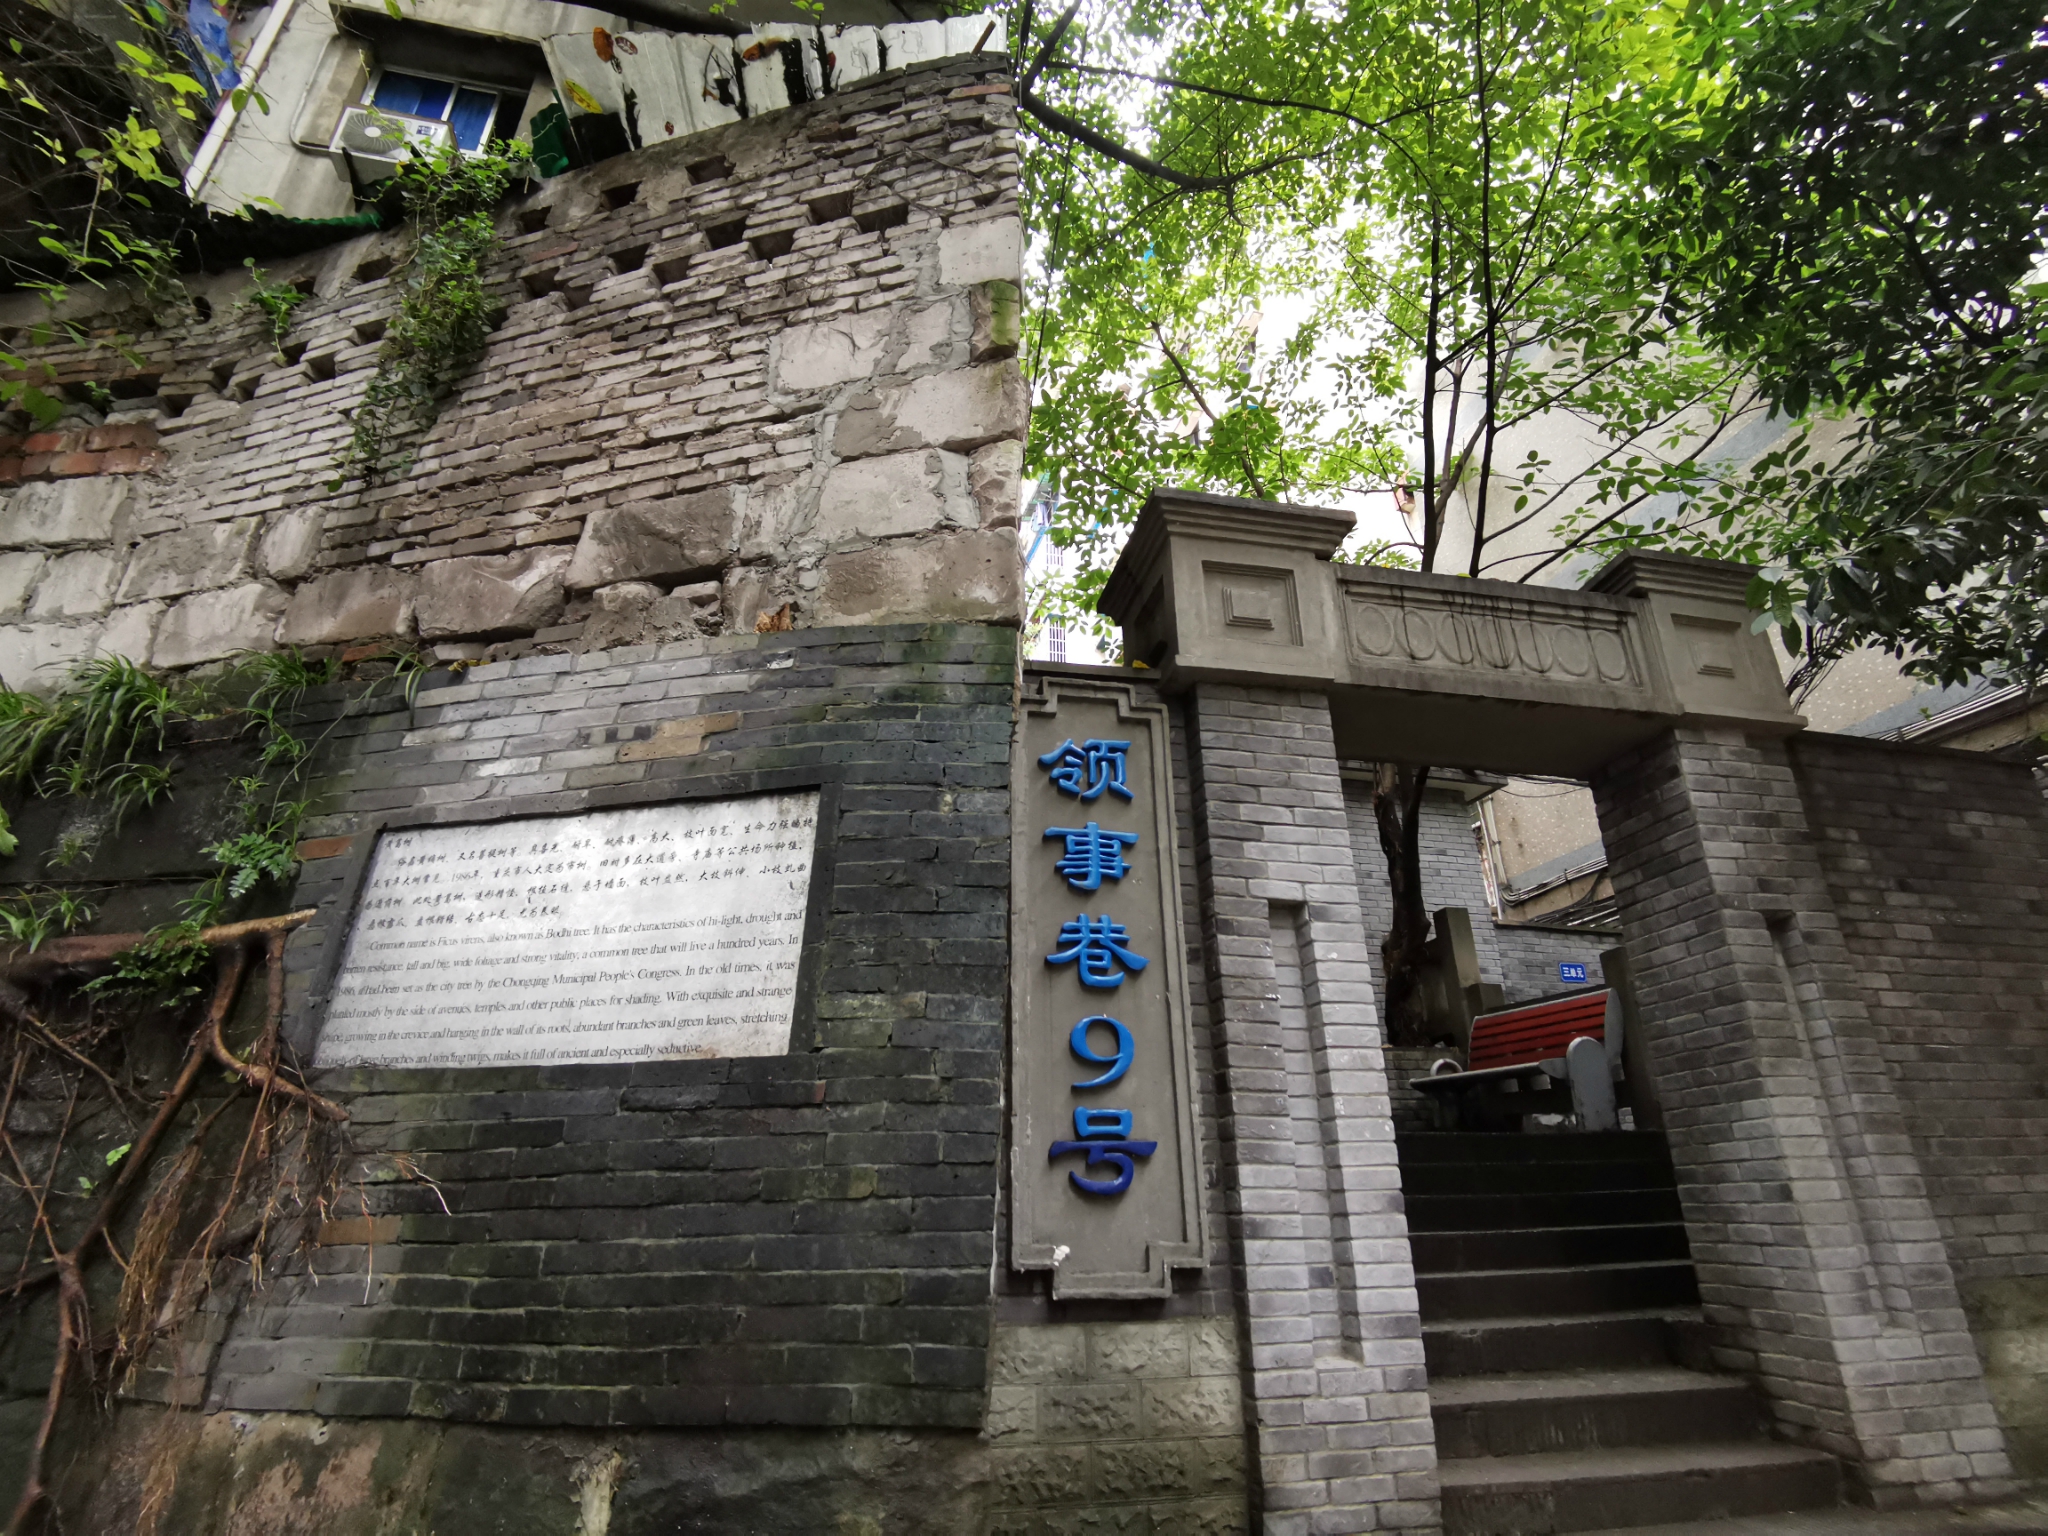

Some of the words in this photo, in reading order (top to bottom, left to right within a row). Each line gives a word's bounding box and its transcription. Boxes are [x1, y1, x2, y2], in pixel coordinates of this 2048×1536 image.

[369, 941, 405, 950] Common
[429, 937, 436, 946] is
[436, 936, 459, 945] Ficus
[487, 932, 503, 942] also
[504, 931, 533, 940] known
[545, 927, 572, 937] Bodhi
[593, 925, 600, 934] It
[601, 924, 616, 933] has
[618, 923, 632, 932] the
[633, 919, 695, 931] characteristics
[696, 917, 707, 927] of
[745, 912, 782, 925] drought
[784, 910, 802, 920] and
[406, 960, 419, 969] tall
[419, 959, 435, 968] and
[452, 957, 473, 966] wide
[474, 955, 503, 967] foliage
[503, 953, 519, 963] and
[520, 954, 546, 964] strong
[589, 949, 629, 957] common
[631, 946, 648, 954] tree
[650, 943, 667, 953] that
[669, 941, 687, 952] will
[689, 941, 706, 950] live
[716, 937, 755, 949] hundred
[788, 934, 798, 944] In
[1040, 739, 1157, 1193] 领事巷9号
[364, 984, 381, 994] had
[381, 984, 400, 993] been
[401, 984, 413, 992] set
[425, 981, 438, 990] the
[439, 981, 455, 992] city
[456, 981, 472, 989] tree
[473, 979, 484, 991] by
[487, 978, 500, 987] the
[501, 976, 549, 988] Chongqing
[552, 972, 596, 985] Municipal
[598, 969, 634, 983] People's
[685, 966, 695, 976] In
[698, 965, 713, 975] the
[715, 963, 731, 974] old
[766, 961, 773, 970] it
[776, 962, 795, 970] was
[1562, 966, 1584, 978] 三单元
[327, 1008, 356, 1021] planted
[356, 1007, 381, 1019] mostly
[383, 1006, 395, 1018] by
[395, 1006, 408, 1015] the
[409, 1005, 426, 1014] side
[427, 1004, 437, 1014] of
[474, 1001, 506, 1014] temples
[507, 1000, 525, 1010] and
[525, 999, 548, 1009] other
[549, 997, 576, 1011] public
[578, 996, 606, 1009] places
[609, 995, 623, 1005] for
[665, 990, 689, 1001] With
[690, 989, 733, 1002] exquisite
[735, 986, 754, 997] and
[756, 987, 792, 998] strange
[344, 1031, 377, 1044] growing
[377, 1031, 386, 1039] in
[386, 1030, 400, 1039] the
[400, 1029, 428, 1038] crevice
[429, 1027, 446, 1037] and
[446, 1027, 479, 1039] hanging
[480, 1026, 489, 1035] in
[490, 1025, 504, 1035] the
[505, 1024, 524, 1034] wall
[524, 1023, 536, 1033] of
[536, 1024, 546, 1033] its
[573, 1020, 614, 1031] abundant
[615, 1018, 656, 1029] branches
[657, 1016, 676, 1027] and
[676, 1018, 704, 1029] green
[740, 1011, 787, 1024] stretching
[379, 1053, 414, 1064] branches
[415, 1052, 432, 1062] and
[432, 1051, 466, 1064] winding
[493, 1049, 521, 1060] makes
[522, 1049, 529, 1058] it
[530, 1048, 545, 1058] full
[545, 1047, 557, 1058] of
[557, 1047, 589, 1057] ancient
[590, 1045, 608, 1056] and
[609, 1043, 655, 1058] especially
